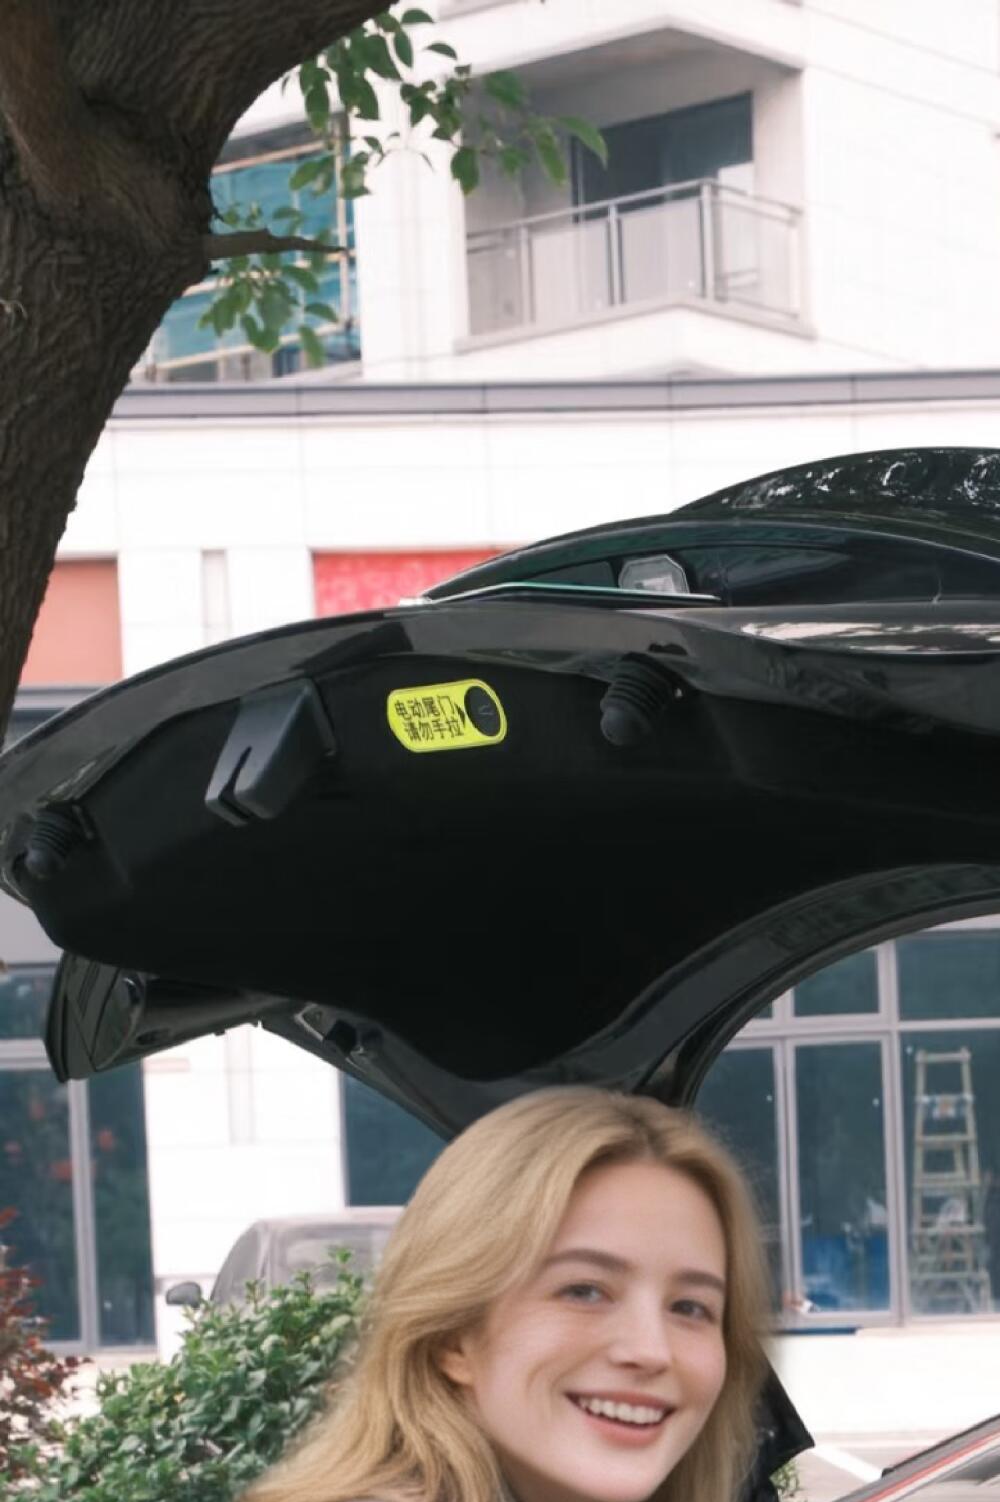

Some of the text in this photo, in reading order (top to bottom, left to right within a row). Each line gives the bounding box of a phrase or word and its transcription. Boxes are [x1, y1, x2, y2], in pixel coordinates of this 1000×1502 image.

[394, 695, 456, 720] 电动尾门
[404, 717, 465, 741] 请勿手拉
